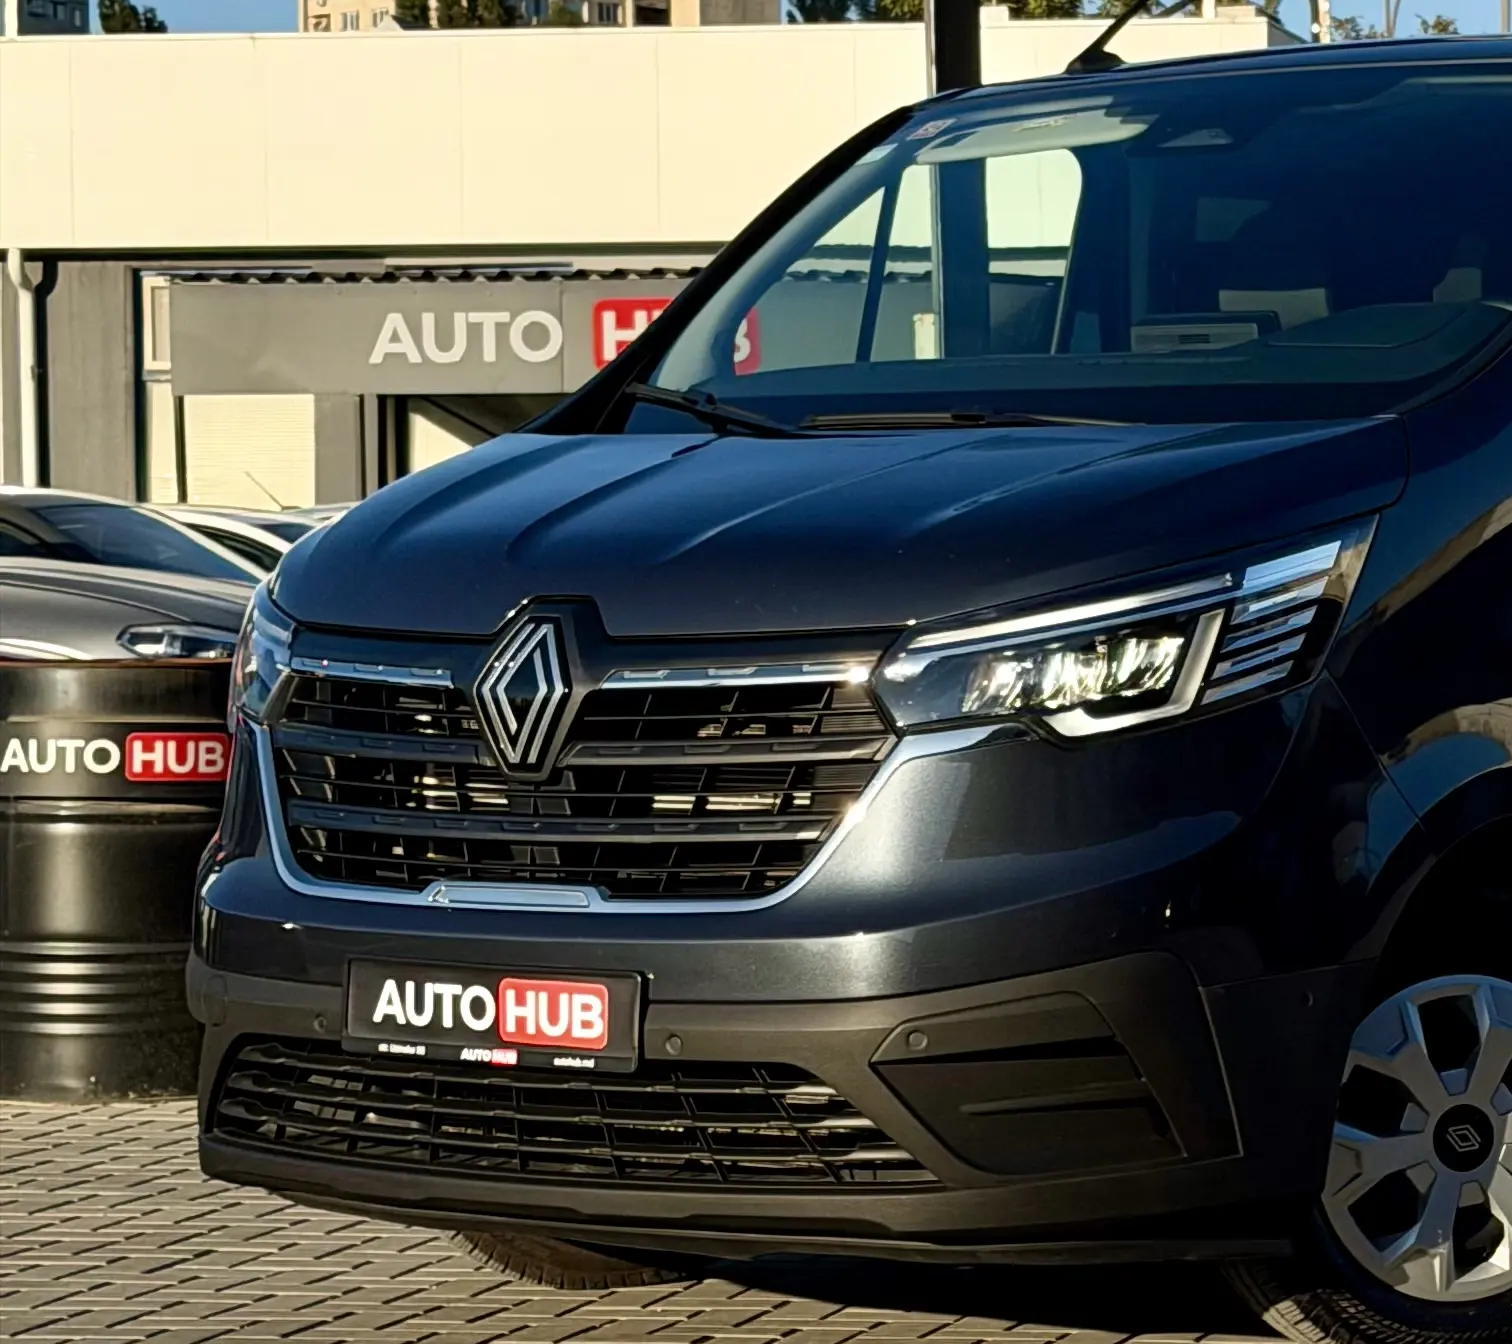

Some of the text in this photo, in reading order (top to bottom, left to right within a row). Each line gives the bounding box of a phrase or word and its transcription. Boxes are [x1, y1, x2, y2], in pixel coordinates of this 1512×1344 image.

[368, 310, 563, 364] AUTO
[0, 737, 225, 774] AUTO HUB
[372, 979, 604, 1039] AUTO HUB
[460, 1047, 492, 1062] AUTO
